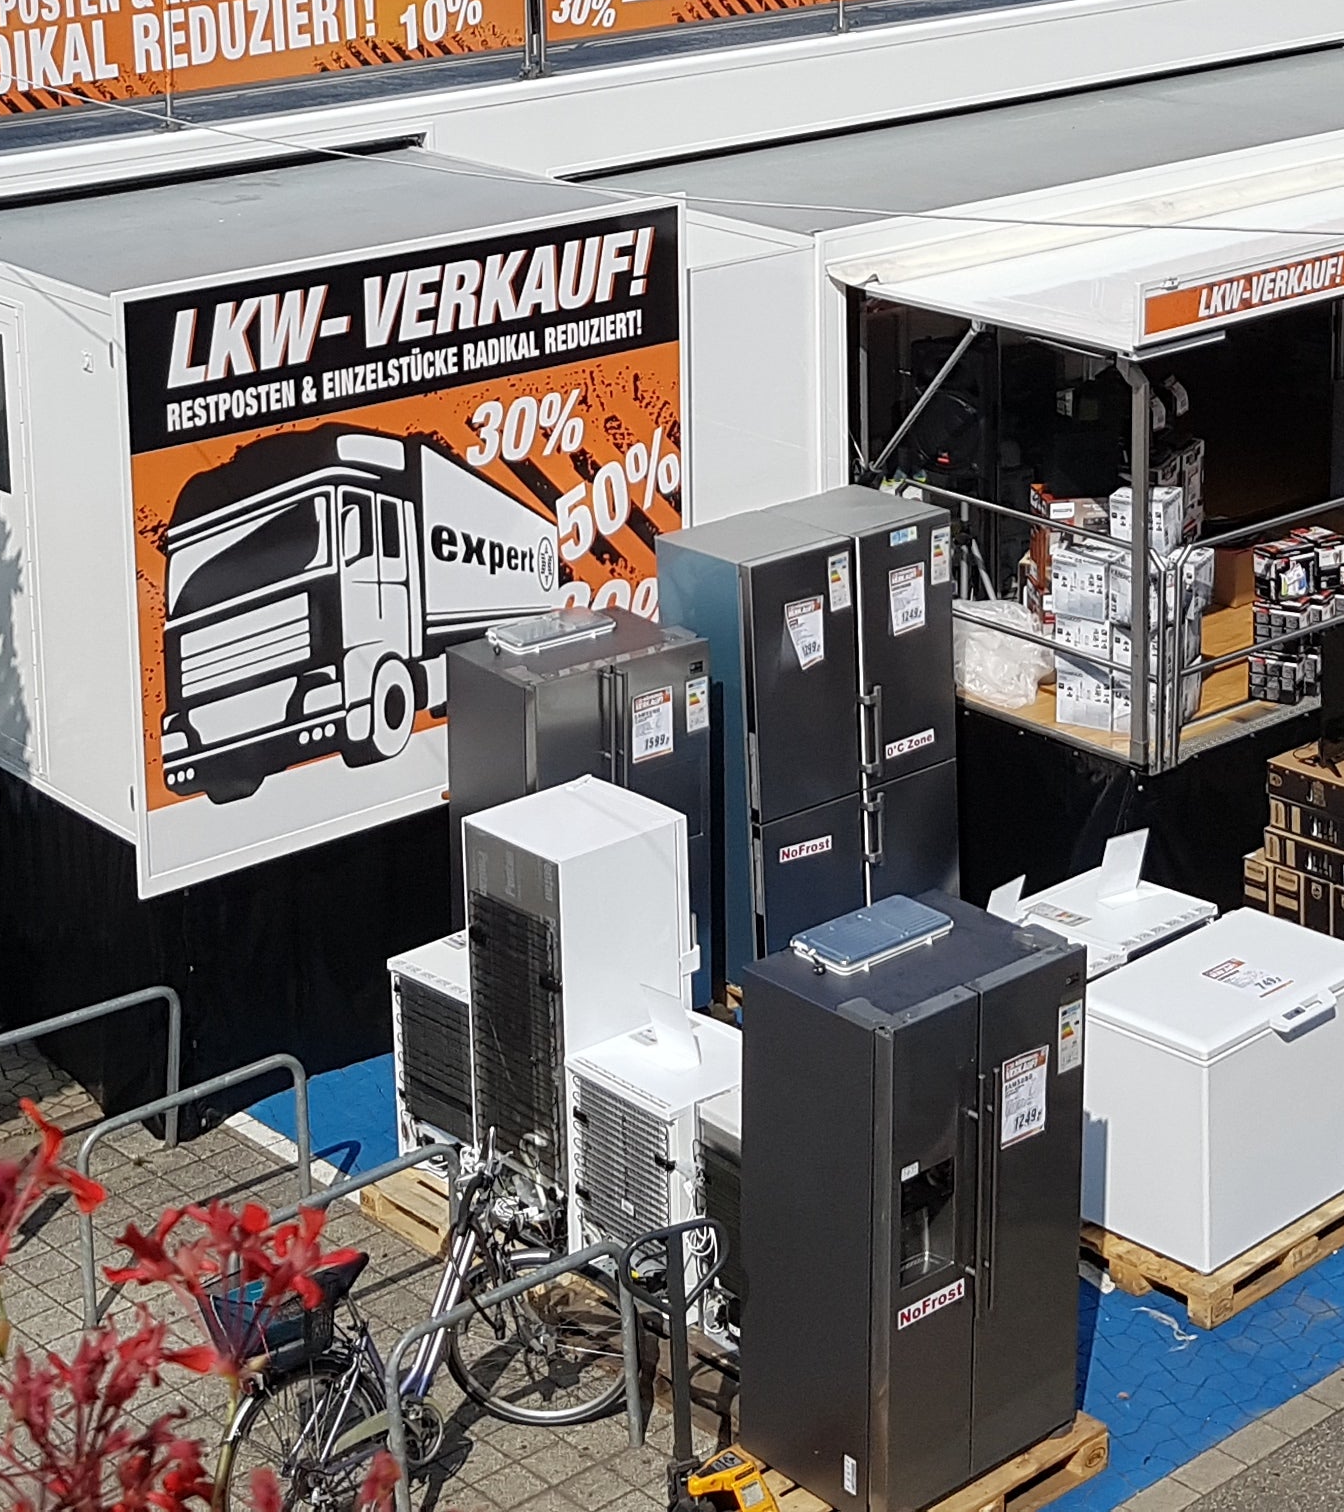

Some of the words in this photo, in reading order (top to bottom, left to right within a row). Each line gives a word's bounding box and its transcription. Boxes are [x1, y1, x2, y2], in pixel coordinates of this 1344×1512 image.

[167, 284, 351, 390] LKW-
[363, 225, 656, 348] VERKAUF!
[1197, 255, 1344, 319] LKW-VERKAUF!
[166, 382, 296, 433] RESTPOSTEN
[301, 375, 317, 403] &
[323, 346, 459, 402] EINZELSTÜCKE
[462, 329, 541, 372] RADIKAL
[544, 308, 643, 355] REDUZIERT!
[465, 387, 586, 467] 30%
[557, 426, 682, 562] 50%
[430, 521, 536, 576] expert
[907, 733, 933, 749] Zone
[781, 838, 830, 861] NoFrost
[899, 1281, 963, 1327] NoFrost
